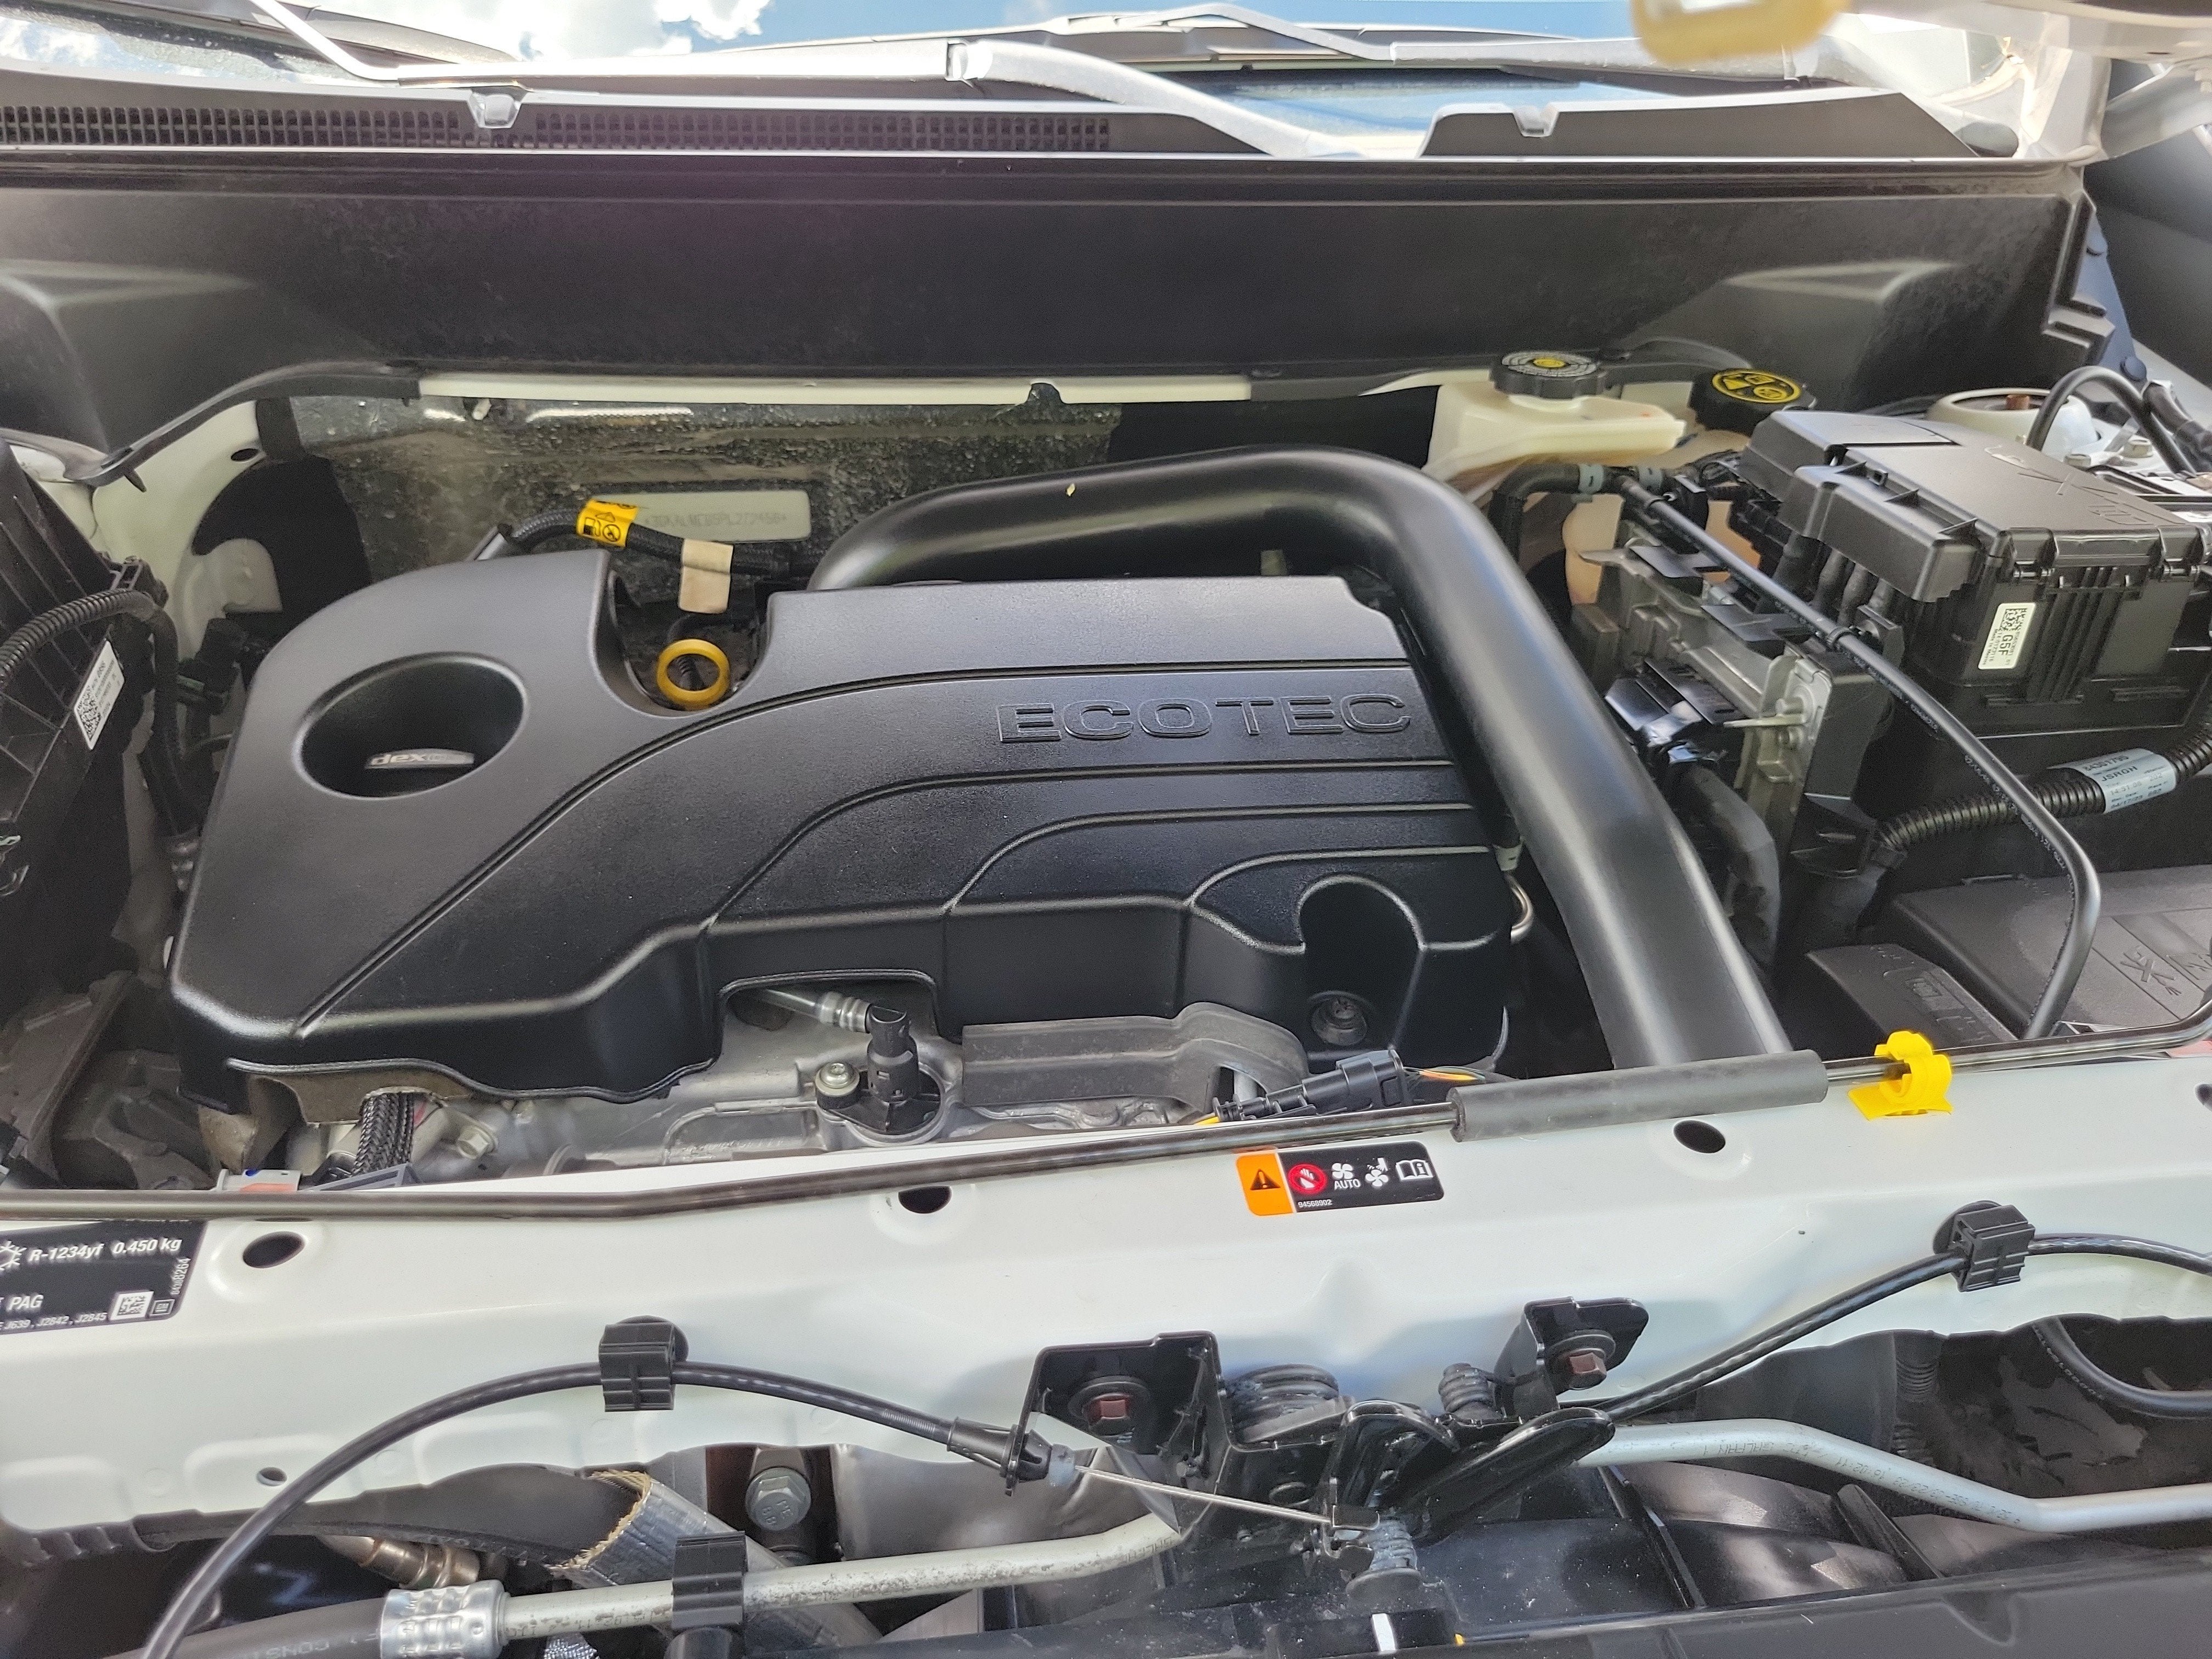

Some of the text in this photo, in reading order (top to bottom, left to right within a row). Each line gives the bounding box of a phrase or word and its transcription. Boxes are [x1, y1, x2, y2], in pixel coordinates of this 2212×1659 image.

[1997, 634, 2014, 656] G5F
[996, 693, 1412, 742] ECOTEC
[2101, 765, 2138, 782] JSRGH
[1334, 1178, 1361, 1190] AUTO
[1297, 1198, 1333, 1208] 94568902
[29, 1237, 183, 1262] R-1234yf 0.450 kg
[7, 1294, 44, 1311] PAG
